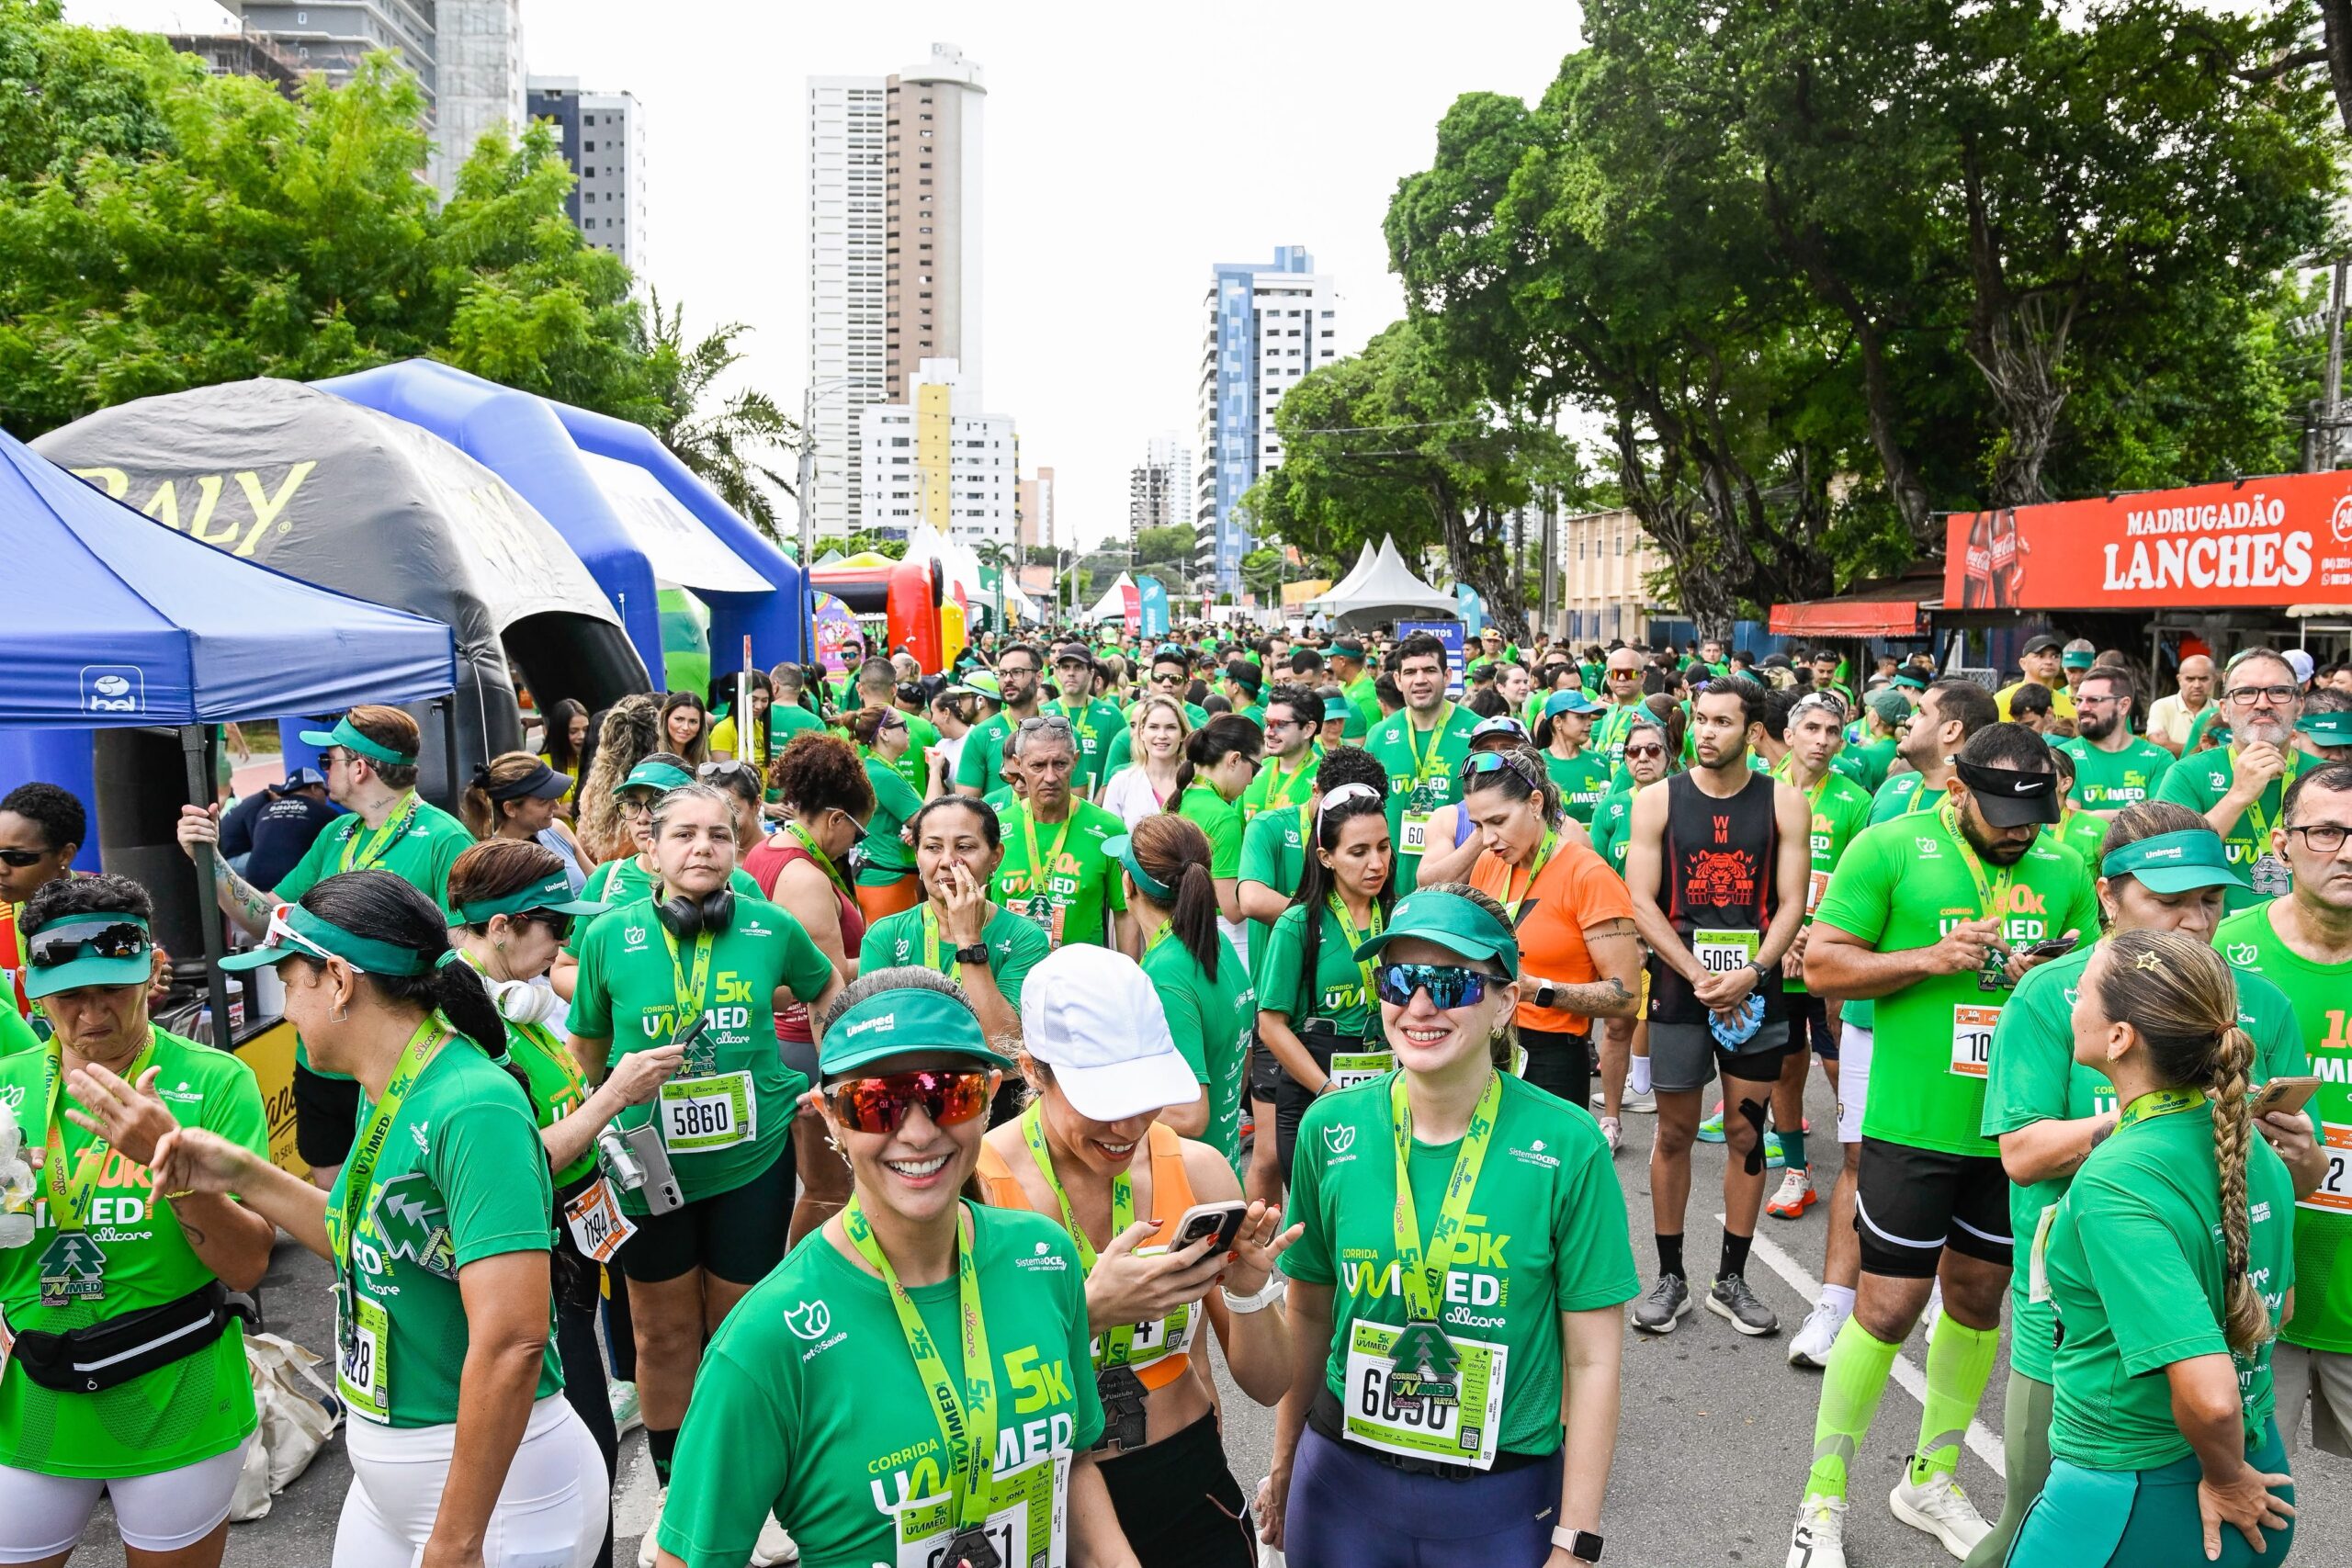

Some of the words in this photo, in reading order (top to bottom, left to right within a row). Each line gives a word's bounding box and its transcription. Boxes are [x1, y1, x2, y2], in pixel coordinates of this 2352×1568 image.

[2127, 493, 2285, 536] MADRUGADÃO
[2102, 530, 2313, 591] LANCHES
[2123, 771, 2146, 787] 5K
[2084, 787, 2145, 802] UNIMED
[1713, 815, 1729, 829] W
[1714, 830, 1727, 843] M
[2145, 847, 2182, 859] Unimed
[545, 879, 568, 892] Unimed
[695, 946, 710, 963] 5K
[1702, 950, 1743, 971] 5065
[715, 971, 753, 1003] 5K
[1326, 983, 1354, 992] CORRIDA
[643, 1004, 676, 1014] CORRIDA
[846, 1013, 895, 1038] Unimed
[875, 1025, 895, 1033] Natal
[415, 1027, 440, 1061] allcare
[716, 1031, 751, 1044] allcare
[389, 1073, 413, 1101] 5K
[673, 1102, 728, 1135] 5860
[1468, 1114, 1491, 1145] 5K
[356, 1116, 391, 1176] UNIMED
[52, 1156, 67, 1196] allcare
[1459, 1156, 1470, 1177] Sistema
[1114, 1181, 1131, 1210] 5K
[92, 1227, 153, 1242] allcare
[849, 1210, 872, 1243] 5K
[1067, 1207, 1084, 1252] allcare
[1434, 1213, 1459, 1244] 5K
[418, 1225, 446, 1266] CORRIDA
[1451, 1213, 1511, 1269] 5K
[381, 1250, 395, 1277] NATAL
[1342, 1248, 1379, 1259] CORRIDA
[1397, 1247, 1419, 1275] 5K
[42, 1280, 103, 1296] UNIMED
[1341, 1258, 1500, 1307] UNIED
[1499, 1278, 1509, 1307] NATAL
[1445, 1306, 1507, 1328] allcare
[964, 1303, 978, 1359] allcare
[1378, 1333, 1390, 1345] 5K
[910, 1326, 936, 1360] 5K
[1356, 1338, 1388, 1352] UNIMED
[1002, 1345, 1073, 1414] 5K
[1391, 1372, 1423, 1382] CORRIDA
[967, 1378, 991, 1415] 5K
[1392, 1381, 1456, 1397] UNIMED
[1433, 1397, 1459, 1406] NATAL
[1464, 1405, 1482, 1414] Sportri
[867, 1438, 940, 1474] CORRIDA
[934, 1506, 948, 1518] 5K
[906, 1517, 946, 1536] UNIMED
